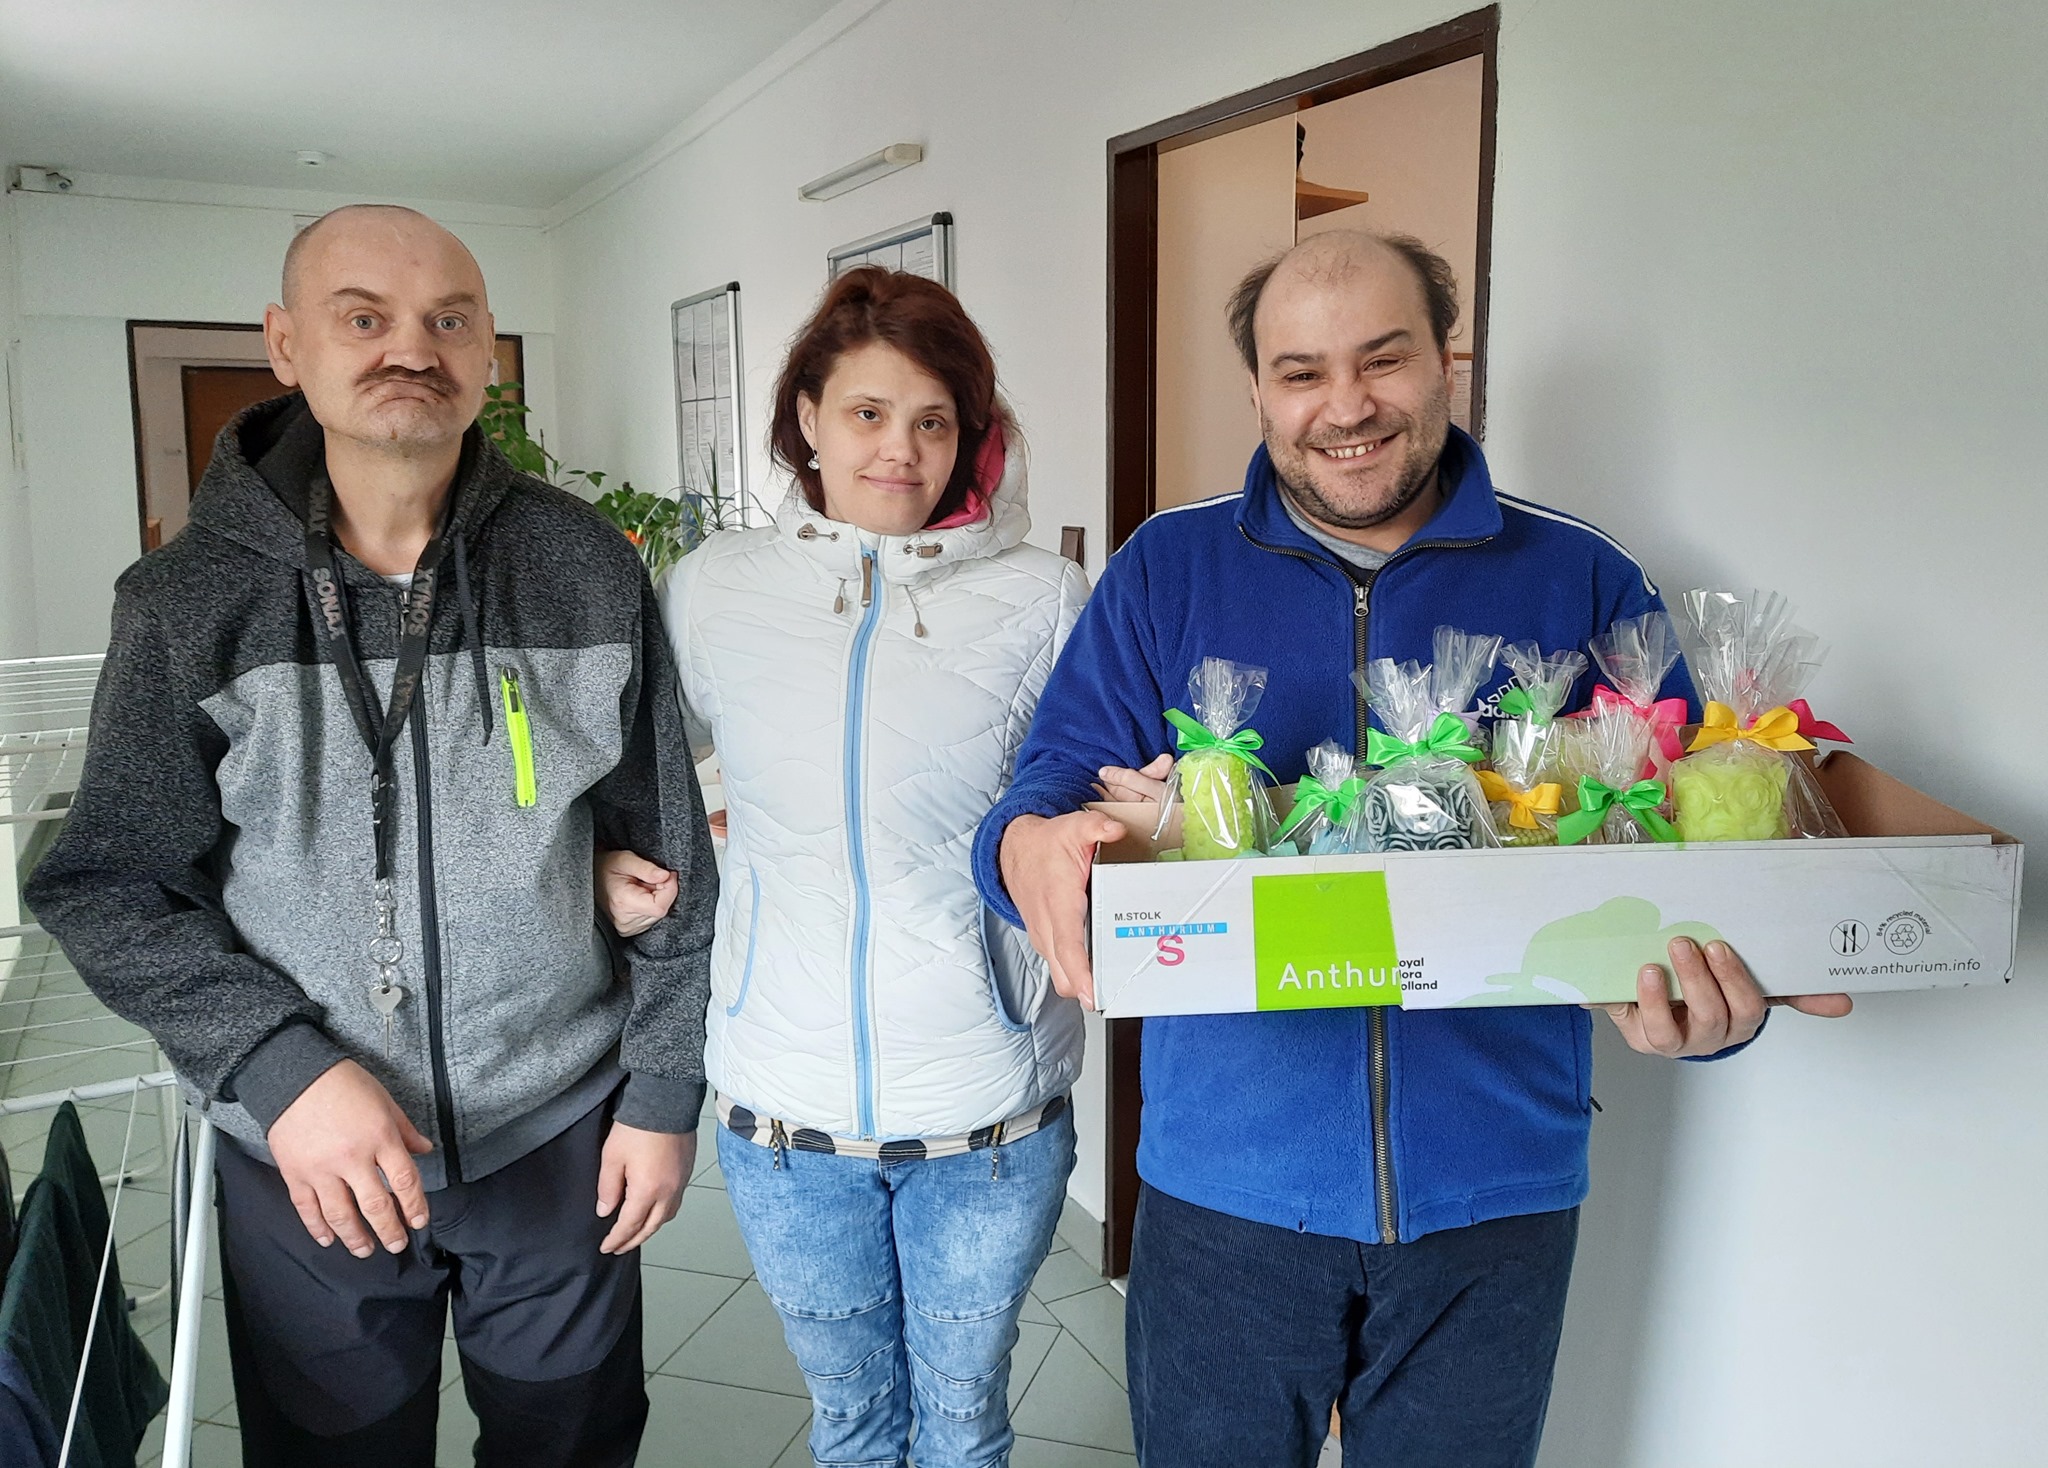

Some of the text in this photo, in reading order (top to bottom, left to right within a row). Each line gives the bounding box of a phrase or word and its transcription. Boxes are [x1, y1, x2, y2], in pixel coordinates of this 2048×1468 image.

[313, 567, 345, 641] SONAX
[408, 567, 434, 637] SONAX
[1114, 911, 1161, 921] M.STOLK
[1886, 910, 1914, 922] recycled
[1913, 913, 1934, 934] material
[1127, 924, 1216, 937] ANTHURIUM
[1156, 935, 1185, 966] S
[1398, 957, 1424, 969] oyal
[1828, 957, 1981, 976] www.anthurium.info
[1277, 960, 1399, 991] Anthur
[1399, 969, 1422, 979] lora
[1401, 980, 1438, 991] olland
